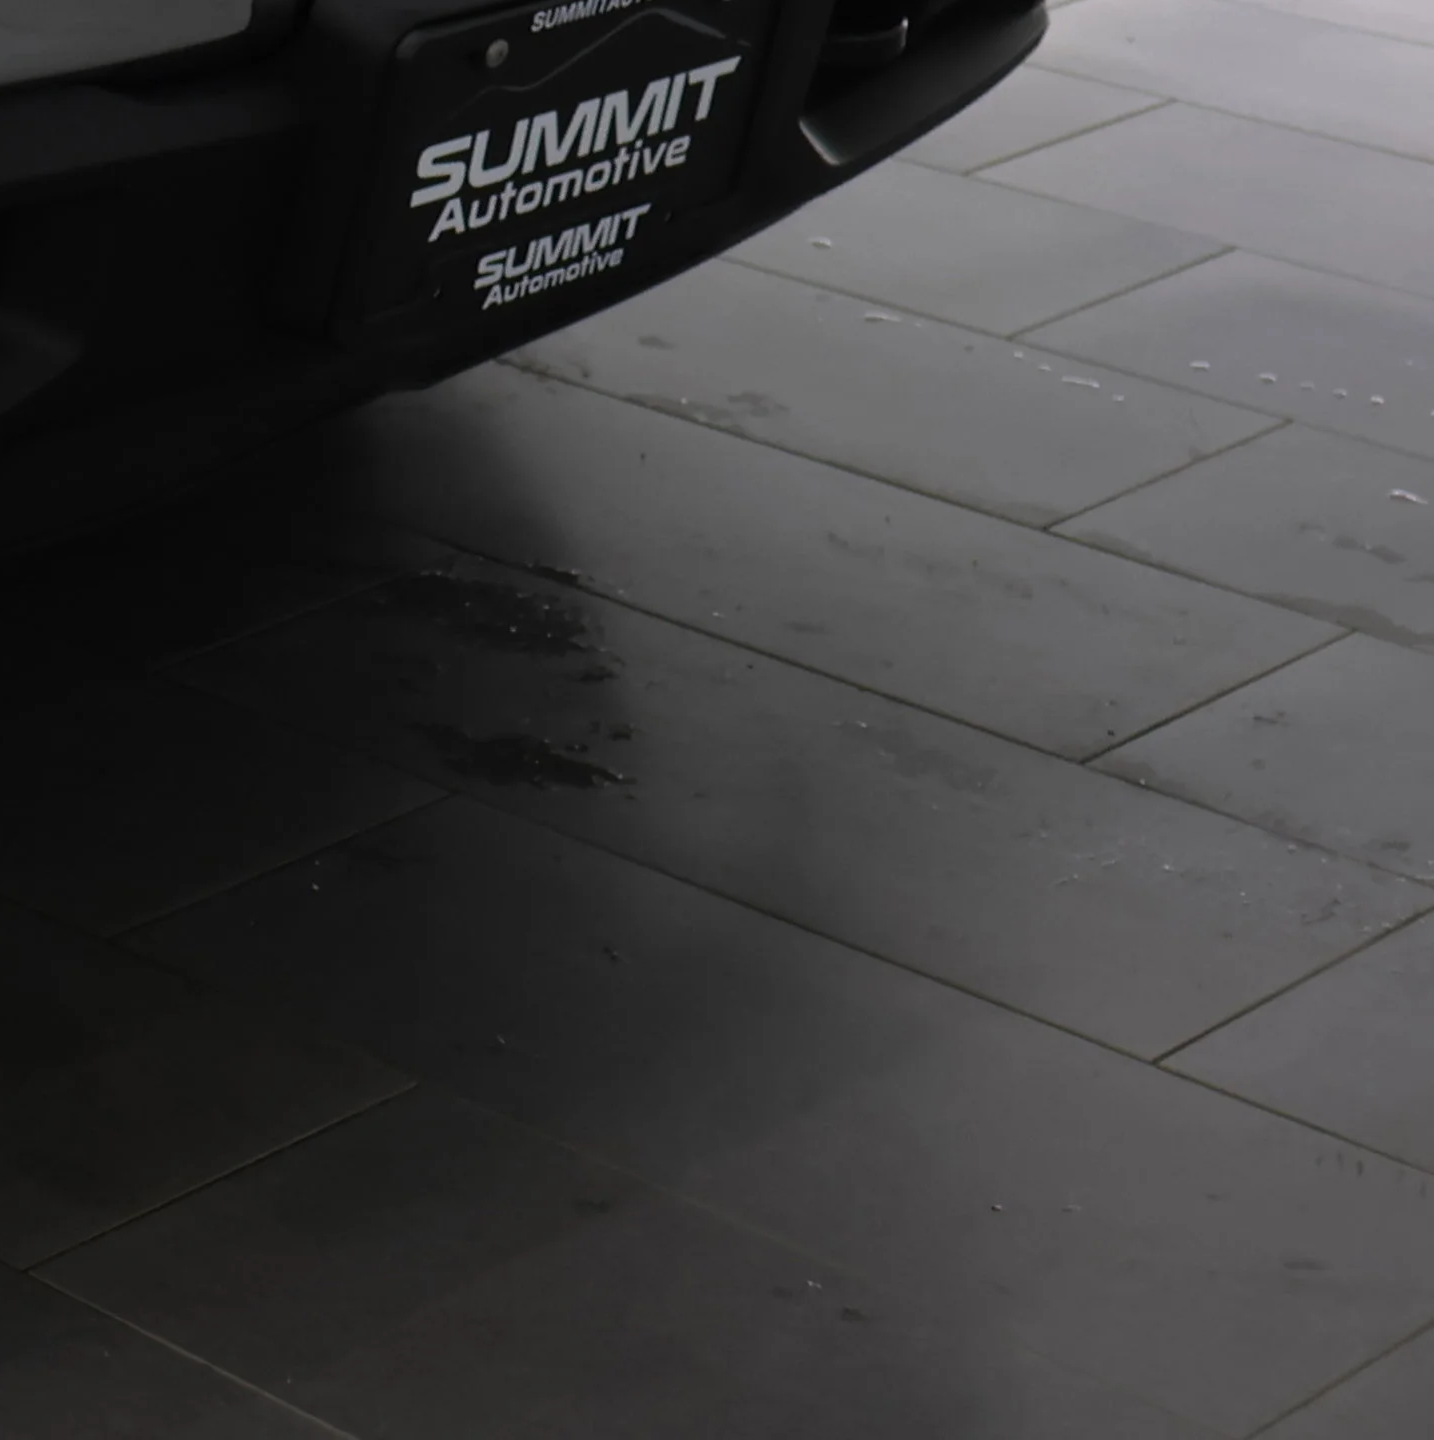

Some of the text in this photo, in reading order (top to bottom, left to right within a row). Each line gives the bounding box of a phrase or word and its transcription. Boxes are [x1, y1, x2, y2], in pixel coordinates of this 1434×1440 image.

[410, 56, 742, 208] SUMMIT
[427, 135, 691, 243] Automotive
[473, 203, 652, 290] SUMMIT
[481, 247, 624, 311] Automotive
